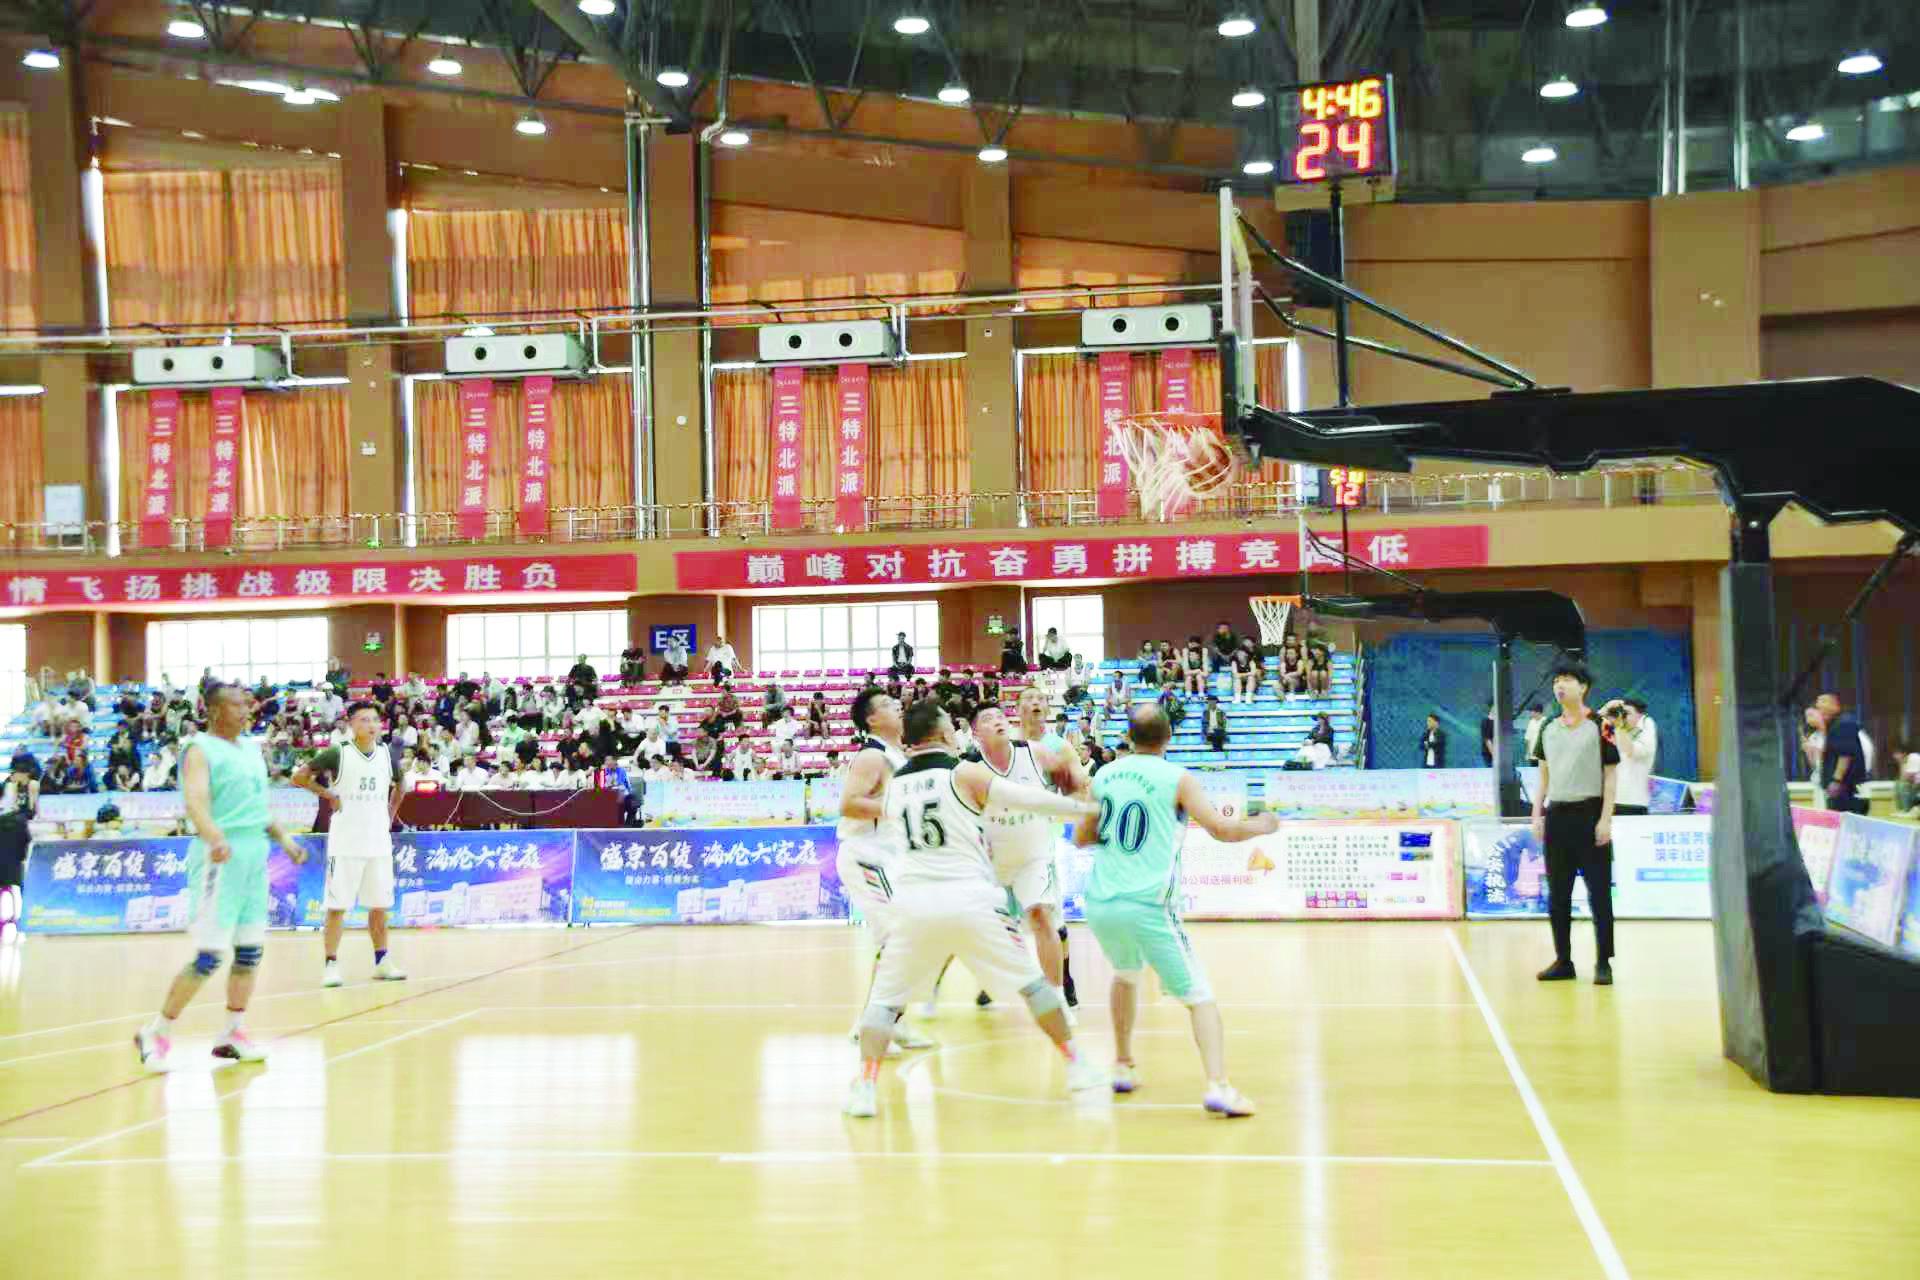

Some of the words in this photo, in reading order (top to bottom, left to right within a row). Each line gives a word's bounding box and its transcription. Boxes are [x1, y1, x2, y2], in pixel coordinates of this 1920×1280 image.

[1303, 79, 1381, 120] 4:46
[1296, 121, 1371, 179] 24
[524, 403, 545, 503] 三特北派
[777, 395, 800, 496] 三特北派
[840, 392, 861, 493] 三特北派
[8, 562, 558, 604] 情飞扬挑战极限决胜负
[902, 801, 944, 850] 15
